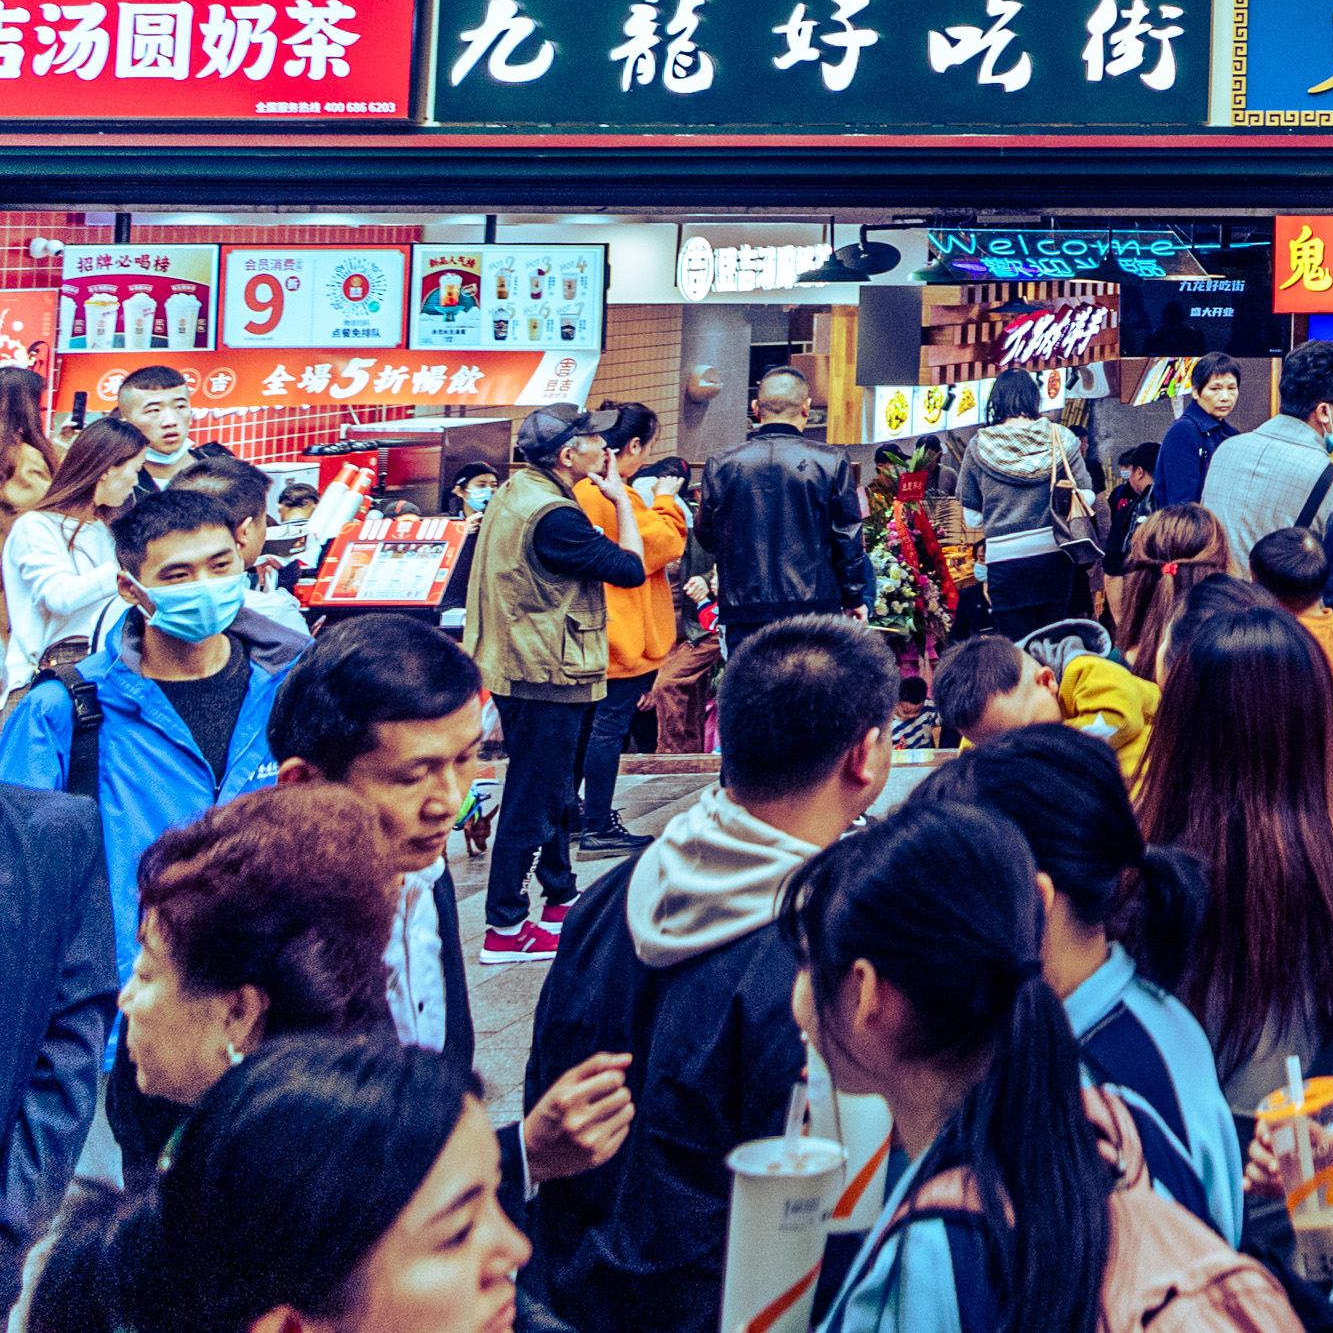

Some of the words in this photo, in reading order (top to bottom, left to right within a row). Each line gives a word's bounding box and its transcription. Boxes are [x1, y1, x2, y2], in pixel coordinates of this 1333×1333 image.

[928, 232, 1177, 256] Welcome
[77, 254, 171, 274] 招牌必喝榜
[1178, 279, 1246, 293] 九龙好吃街
[243, 273, 285, 335] 9
